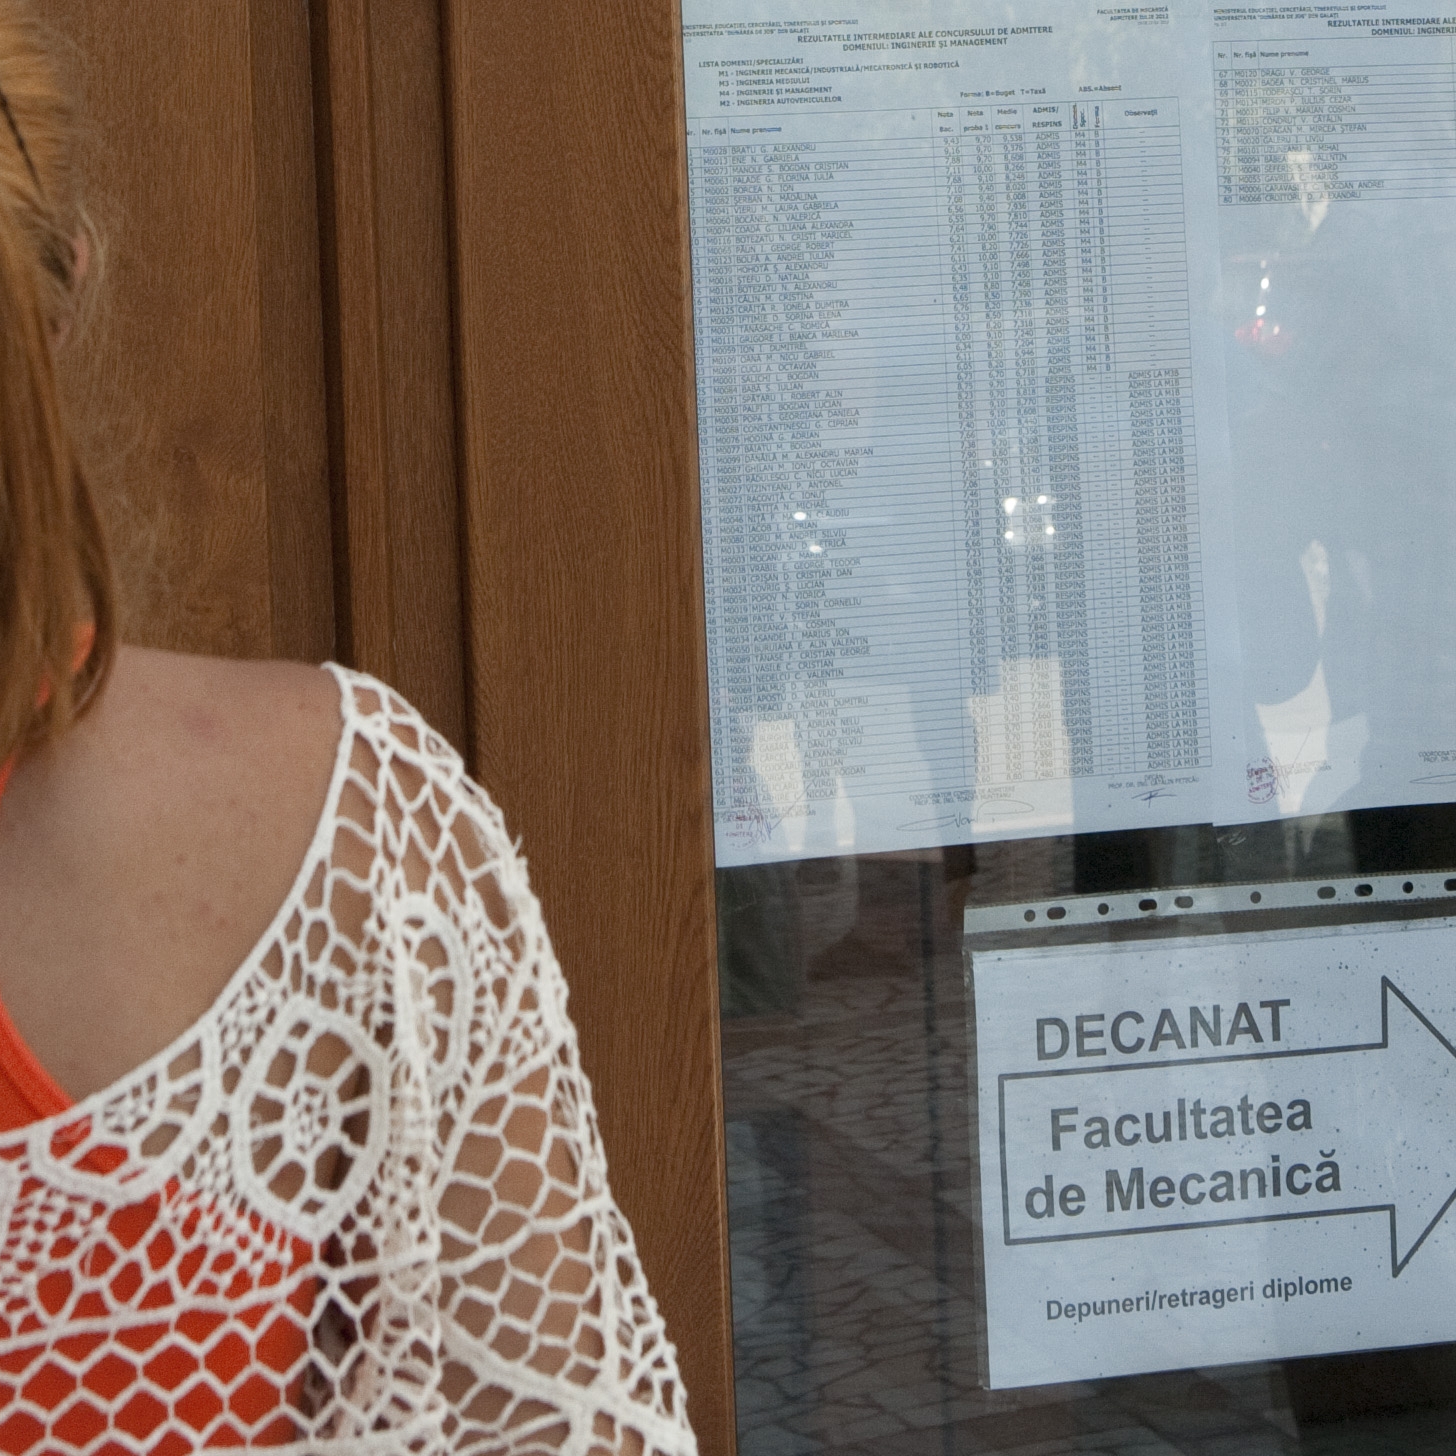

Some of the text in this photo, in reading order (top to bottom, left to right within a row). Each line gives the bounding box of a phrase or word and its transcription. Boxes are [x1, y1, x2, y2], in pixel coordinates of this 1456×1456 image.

[1327, 19, 1379, 28] REZULTATELE
[1381, 17, 1440, 27] INTERMEDIARE
[1442, 17, 1456, 25] ALE
[797, 26, 1053, 43] REZULTATELE INTERMEDIARE ALE CONCURSULUI DE ADMITERE
[1371, 27, 1415, 36] DOMENIUL:
[842, 42, 889, 52] DOMENIUL:
[891, 41, 936, 50] INGINERIE
[949, 38, 1007, 48] MANAGEMENT
[698, 56, 803, 68] LISTA DOMENII/SPECIALIZĂRI
[923, 60, 960, 70] ROBOTICĂ
[718, 77, 810, 88] M3 INGINERIA MEDIULUI
[736, 88, 774, 97] INGINERIE
[784, 87, 832, 95] MANAGEMENT
[736, 98, 775, 106] INGINERIA
[776, 96, 842, 105] AUTOVEHICULELOR
[1035, 998, 1291, 1062] DECANAT
[1049, 1096, 1313, 1152] Facultatea
[1024, 1148, 1342, 1219] de Mecanică
[1046, 1273, 1353, 1322] Depuneri/retrageri diplome
